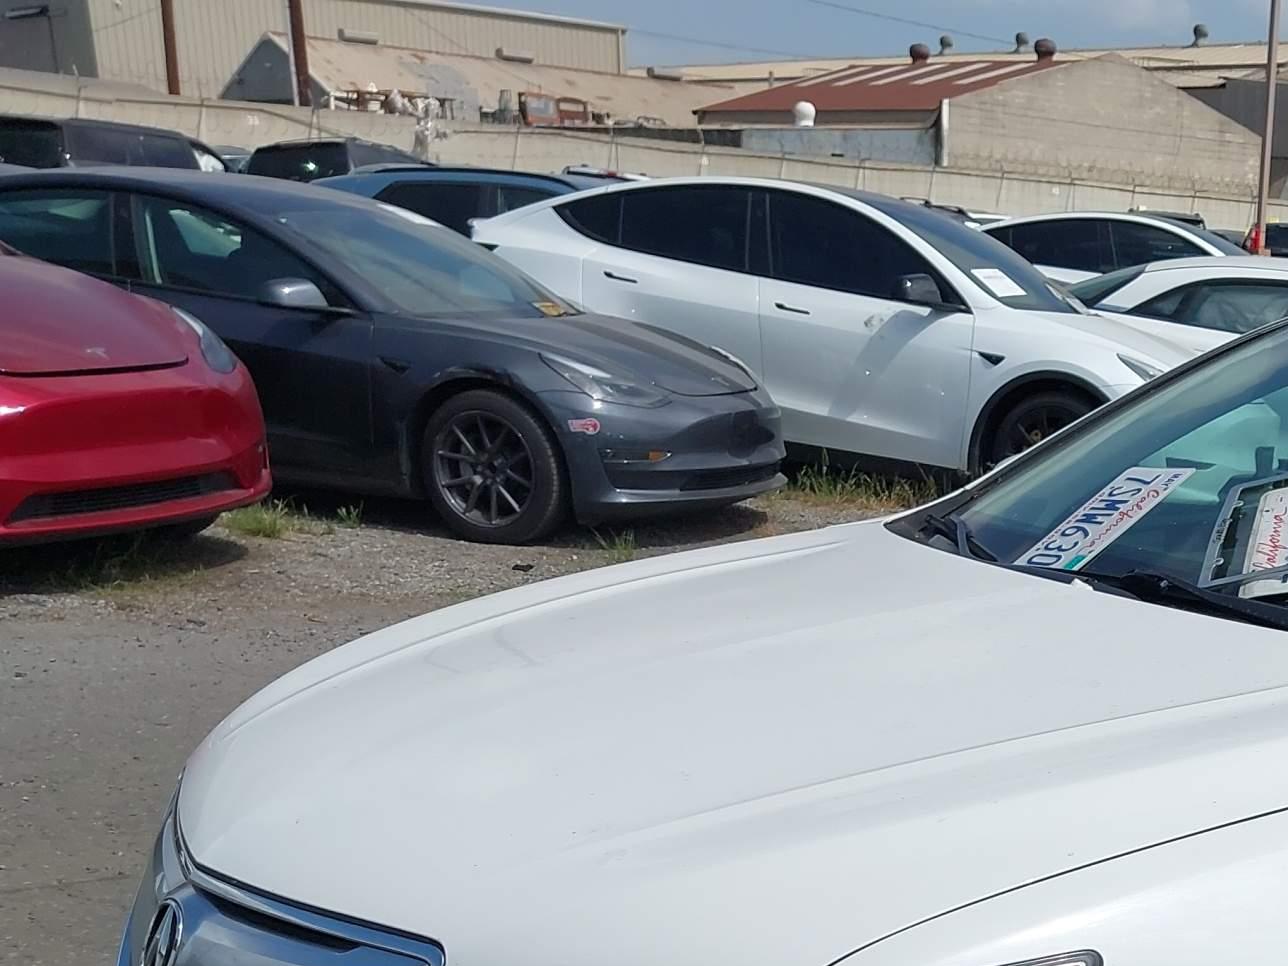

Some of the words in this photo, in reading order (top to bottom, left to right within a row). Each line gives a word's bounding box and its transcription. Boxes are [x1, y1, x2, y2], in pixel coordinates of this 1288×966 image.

[1161, 473, 1183, 488] MAY
[1027, 474, 1162, 566] 7SMW630
[1080, 489, 1160, 553] California
[1252, 506, 1288, 571] California
